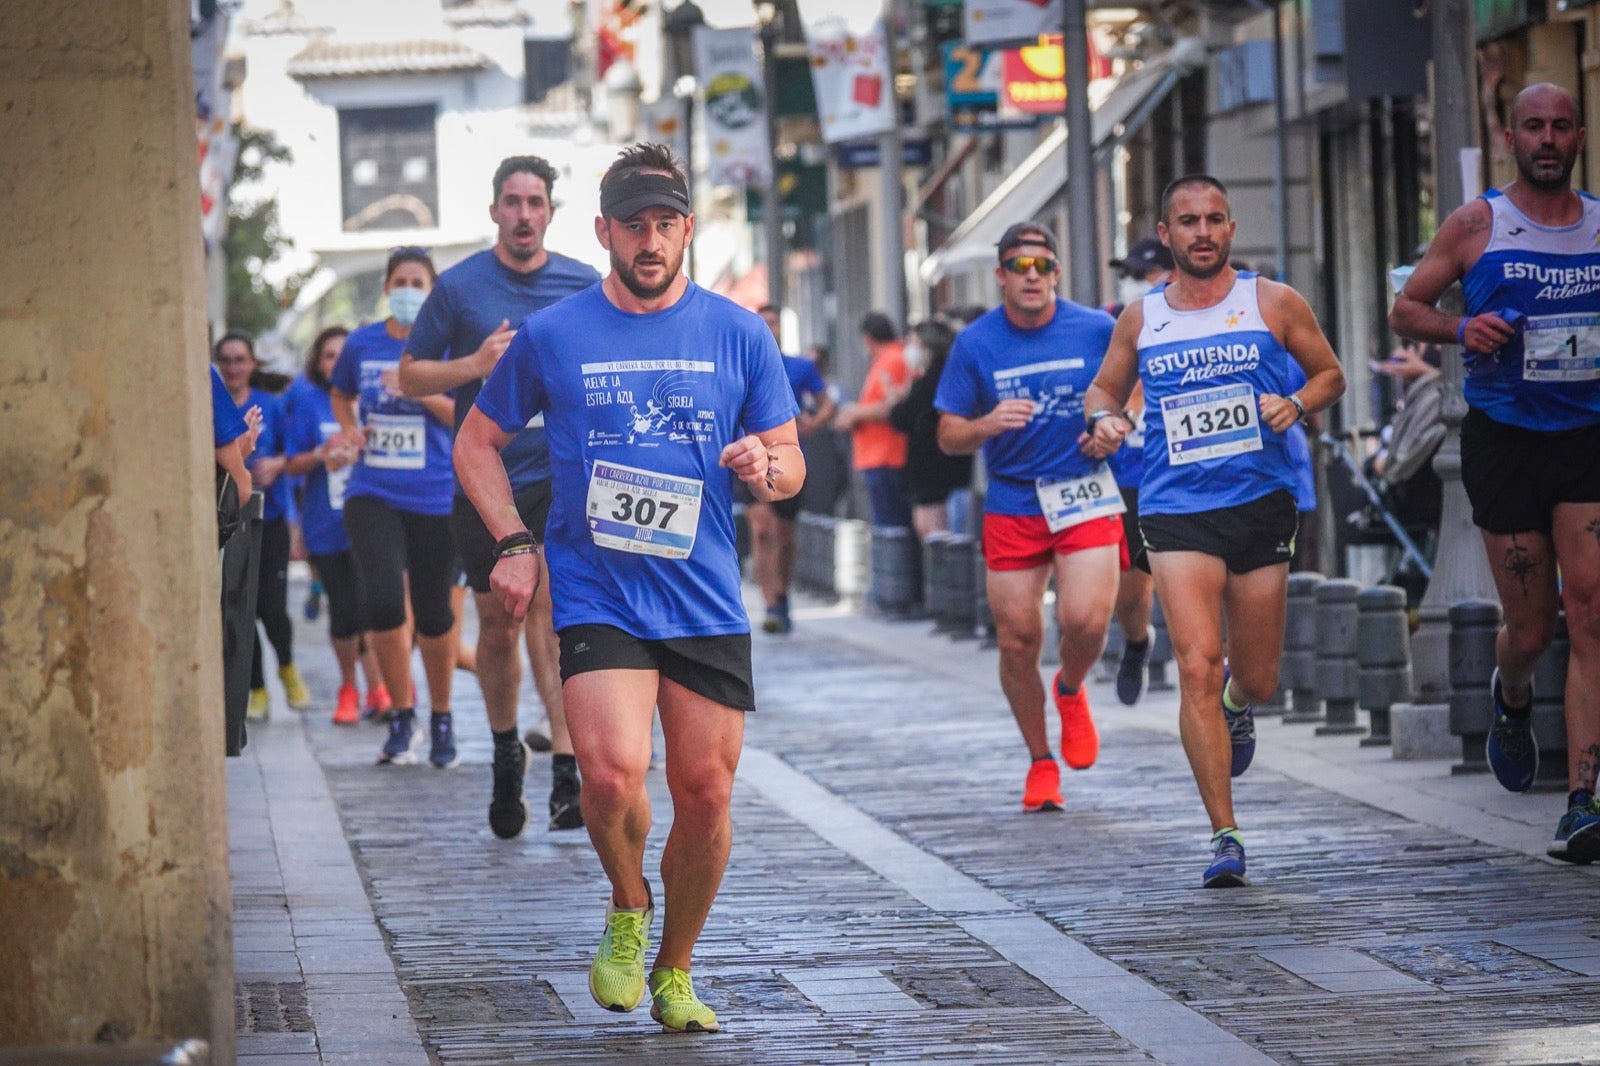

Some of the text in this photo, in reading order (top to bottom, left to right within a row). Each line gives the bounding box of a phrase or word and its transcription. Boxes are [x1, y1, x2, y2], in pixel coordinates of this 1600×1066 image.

[1566, 334, 1578, 357] 1
[1146, 343, 1260, 377] ESTUTIENDA
[583, 375, 621, 390] VUELVE LA
[1180, 361, 1259, 386] Atletismo
[586, 390, 635, 407] ESTELA AZUL
[1180, 404, 1250, 437] 1320
[609, 469, 634, 484] CARRERA
[634, 474, 650, 487] AZUL
[651, 478, 663, 489] POR
[1060, 481, 1103, 506] 549
[611, 492, 679, 529] 307
